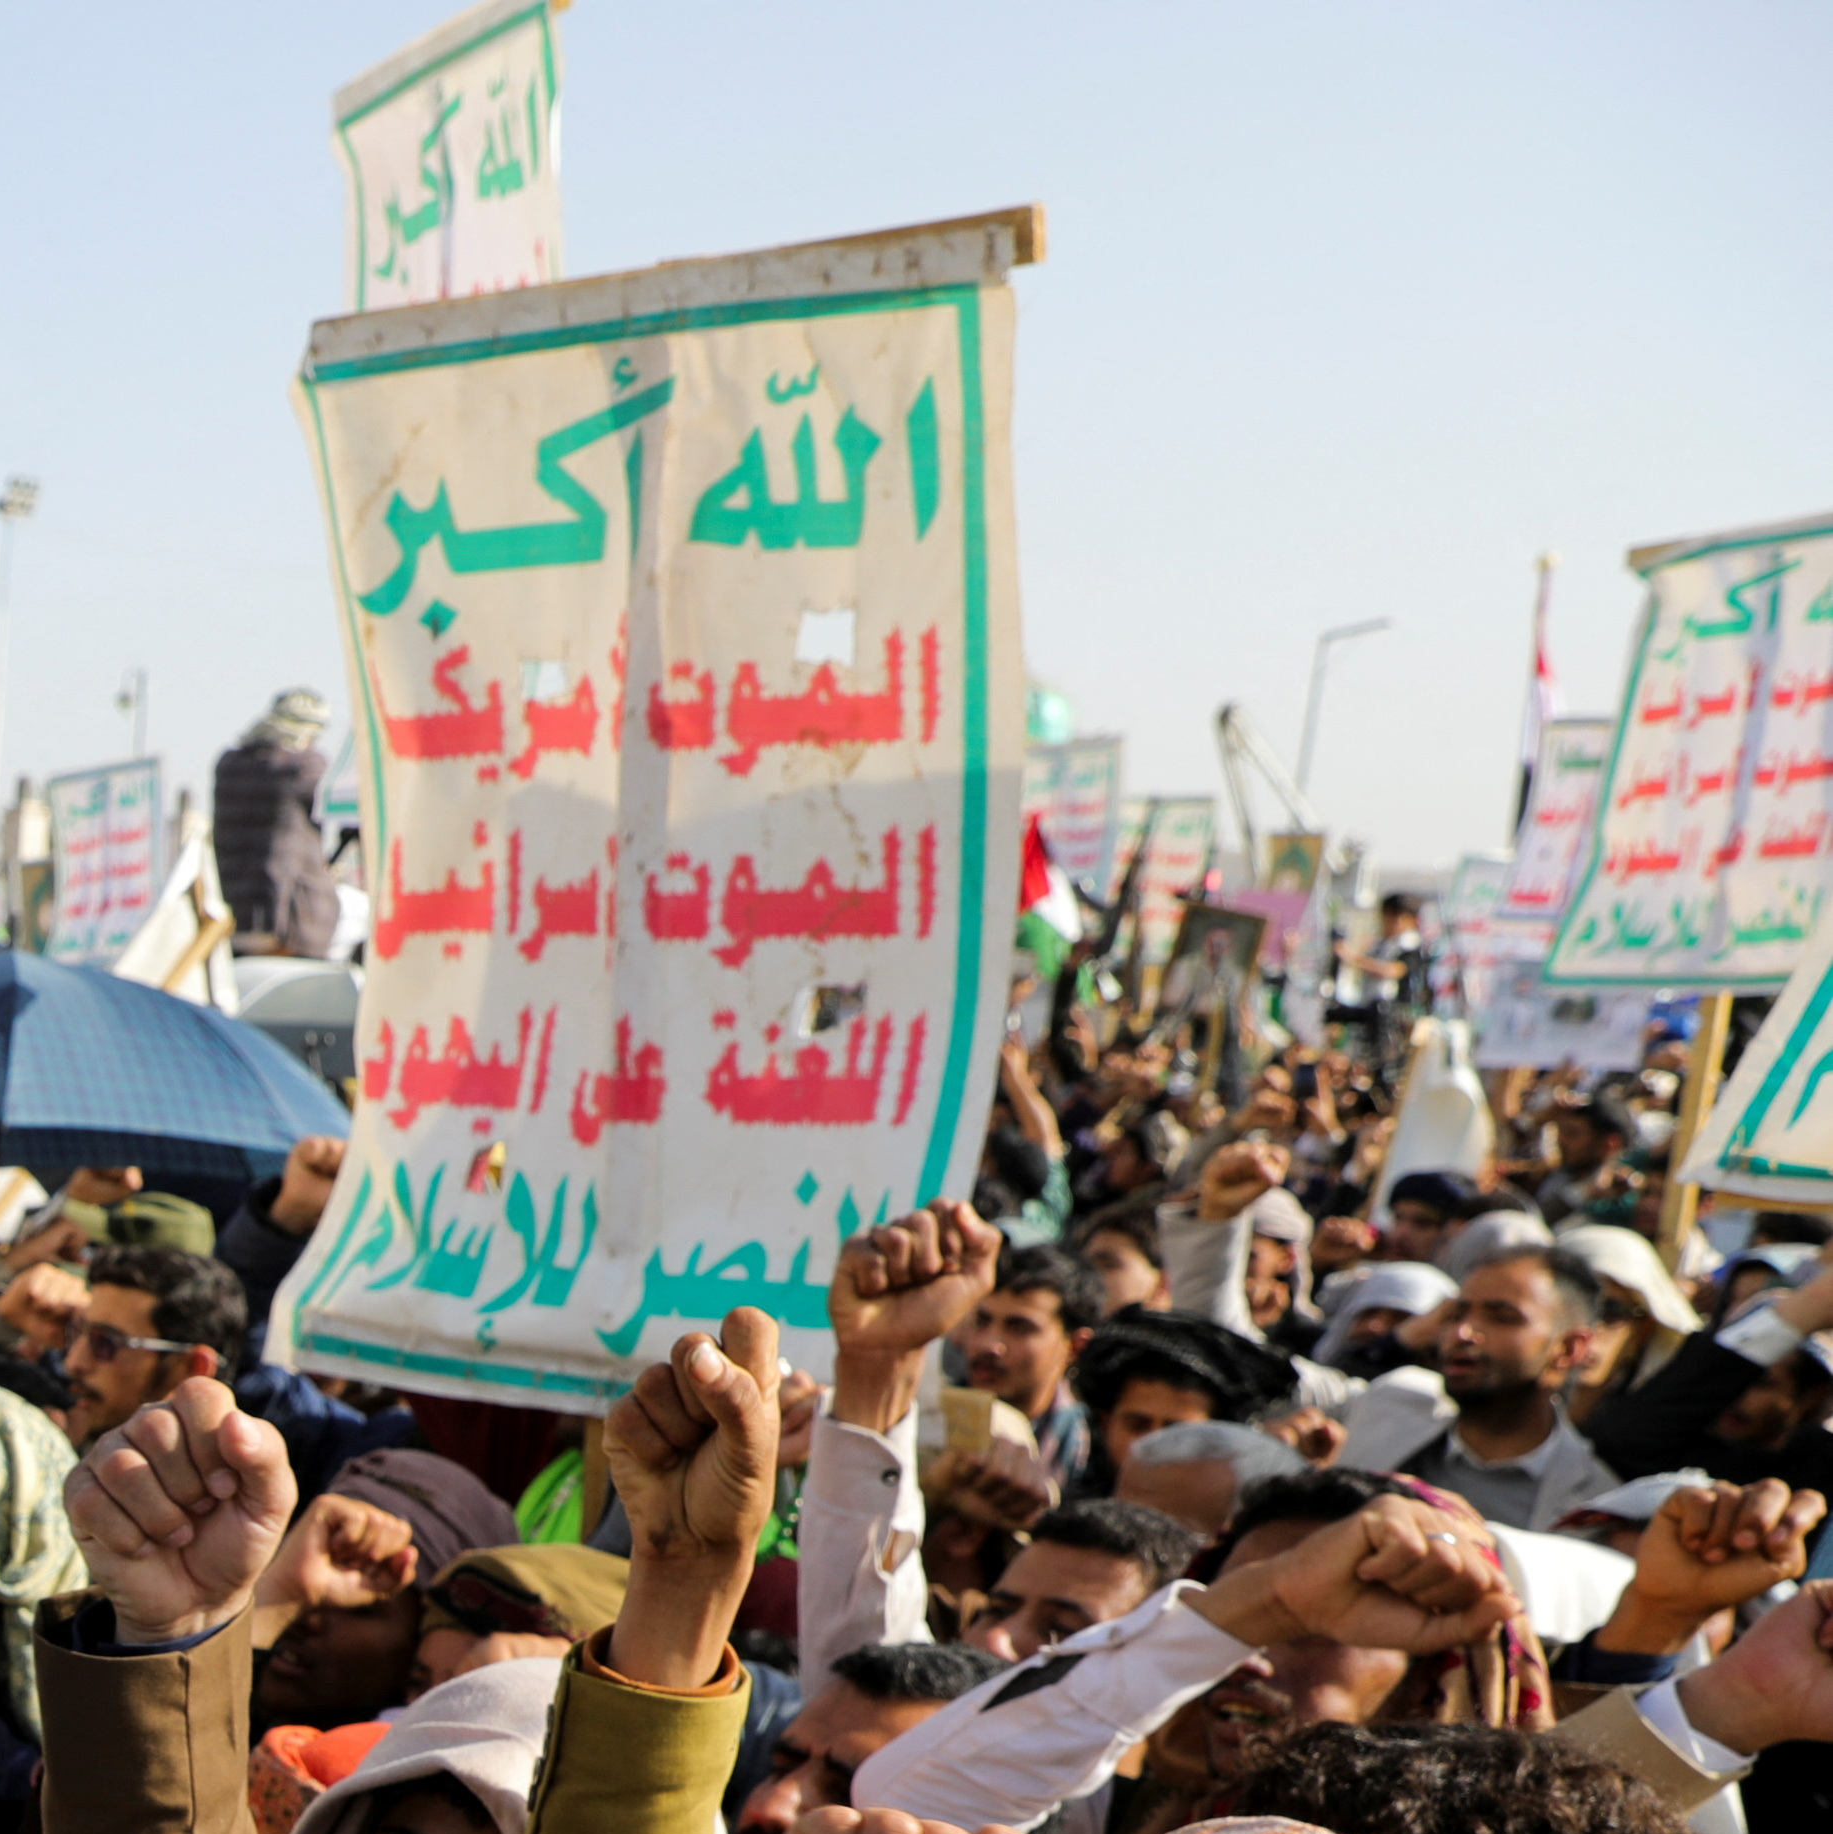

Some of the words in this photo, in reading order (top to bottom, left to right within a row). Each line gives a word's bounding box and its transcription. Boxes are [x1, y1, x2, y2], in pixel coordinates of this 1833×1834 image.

[356, 355, 676, 637] أكبر
[367, 608, 630, 780] أمريكا
[645, 620, 941, 778] الموت
[375, 820, 618, 972] إسرائيل
[640, 822, 937, 969] الموت
[363, 1003, 558, 1136] اليهود
[570, 1011, 668, 1148] على
[704, 1008, 927, 1129] اللعنة
